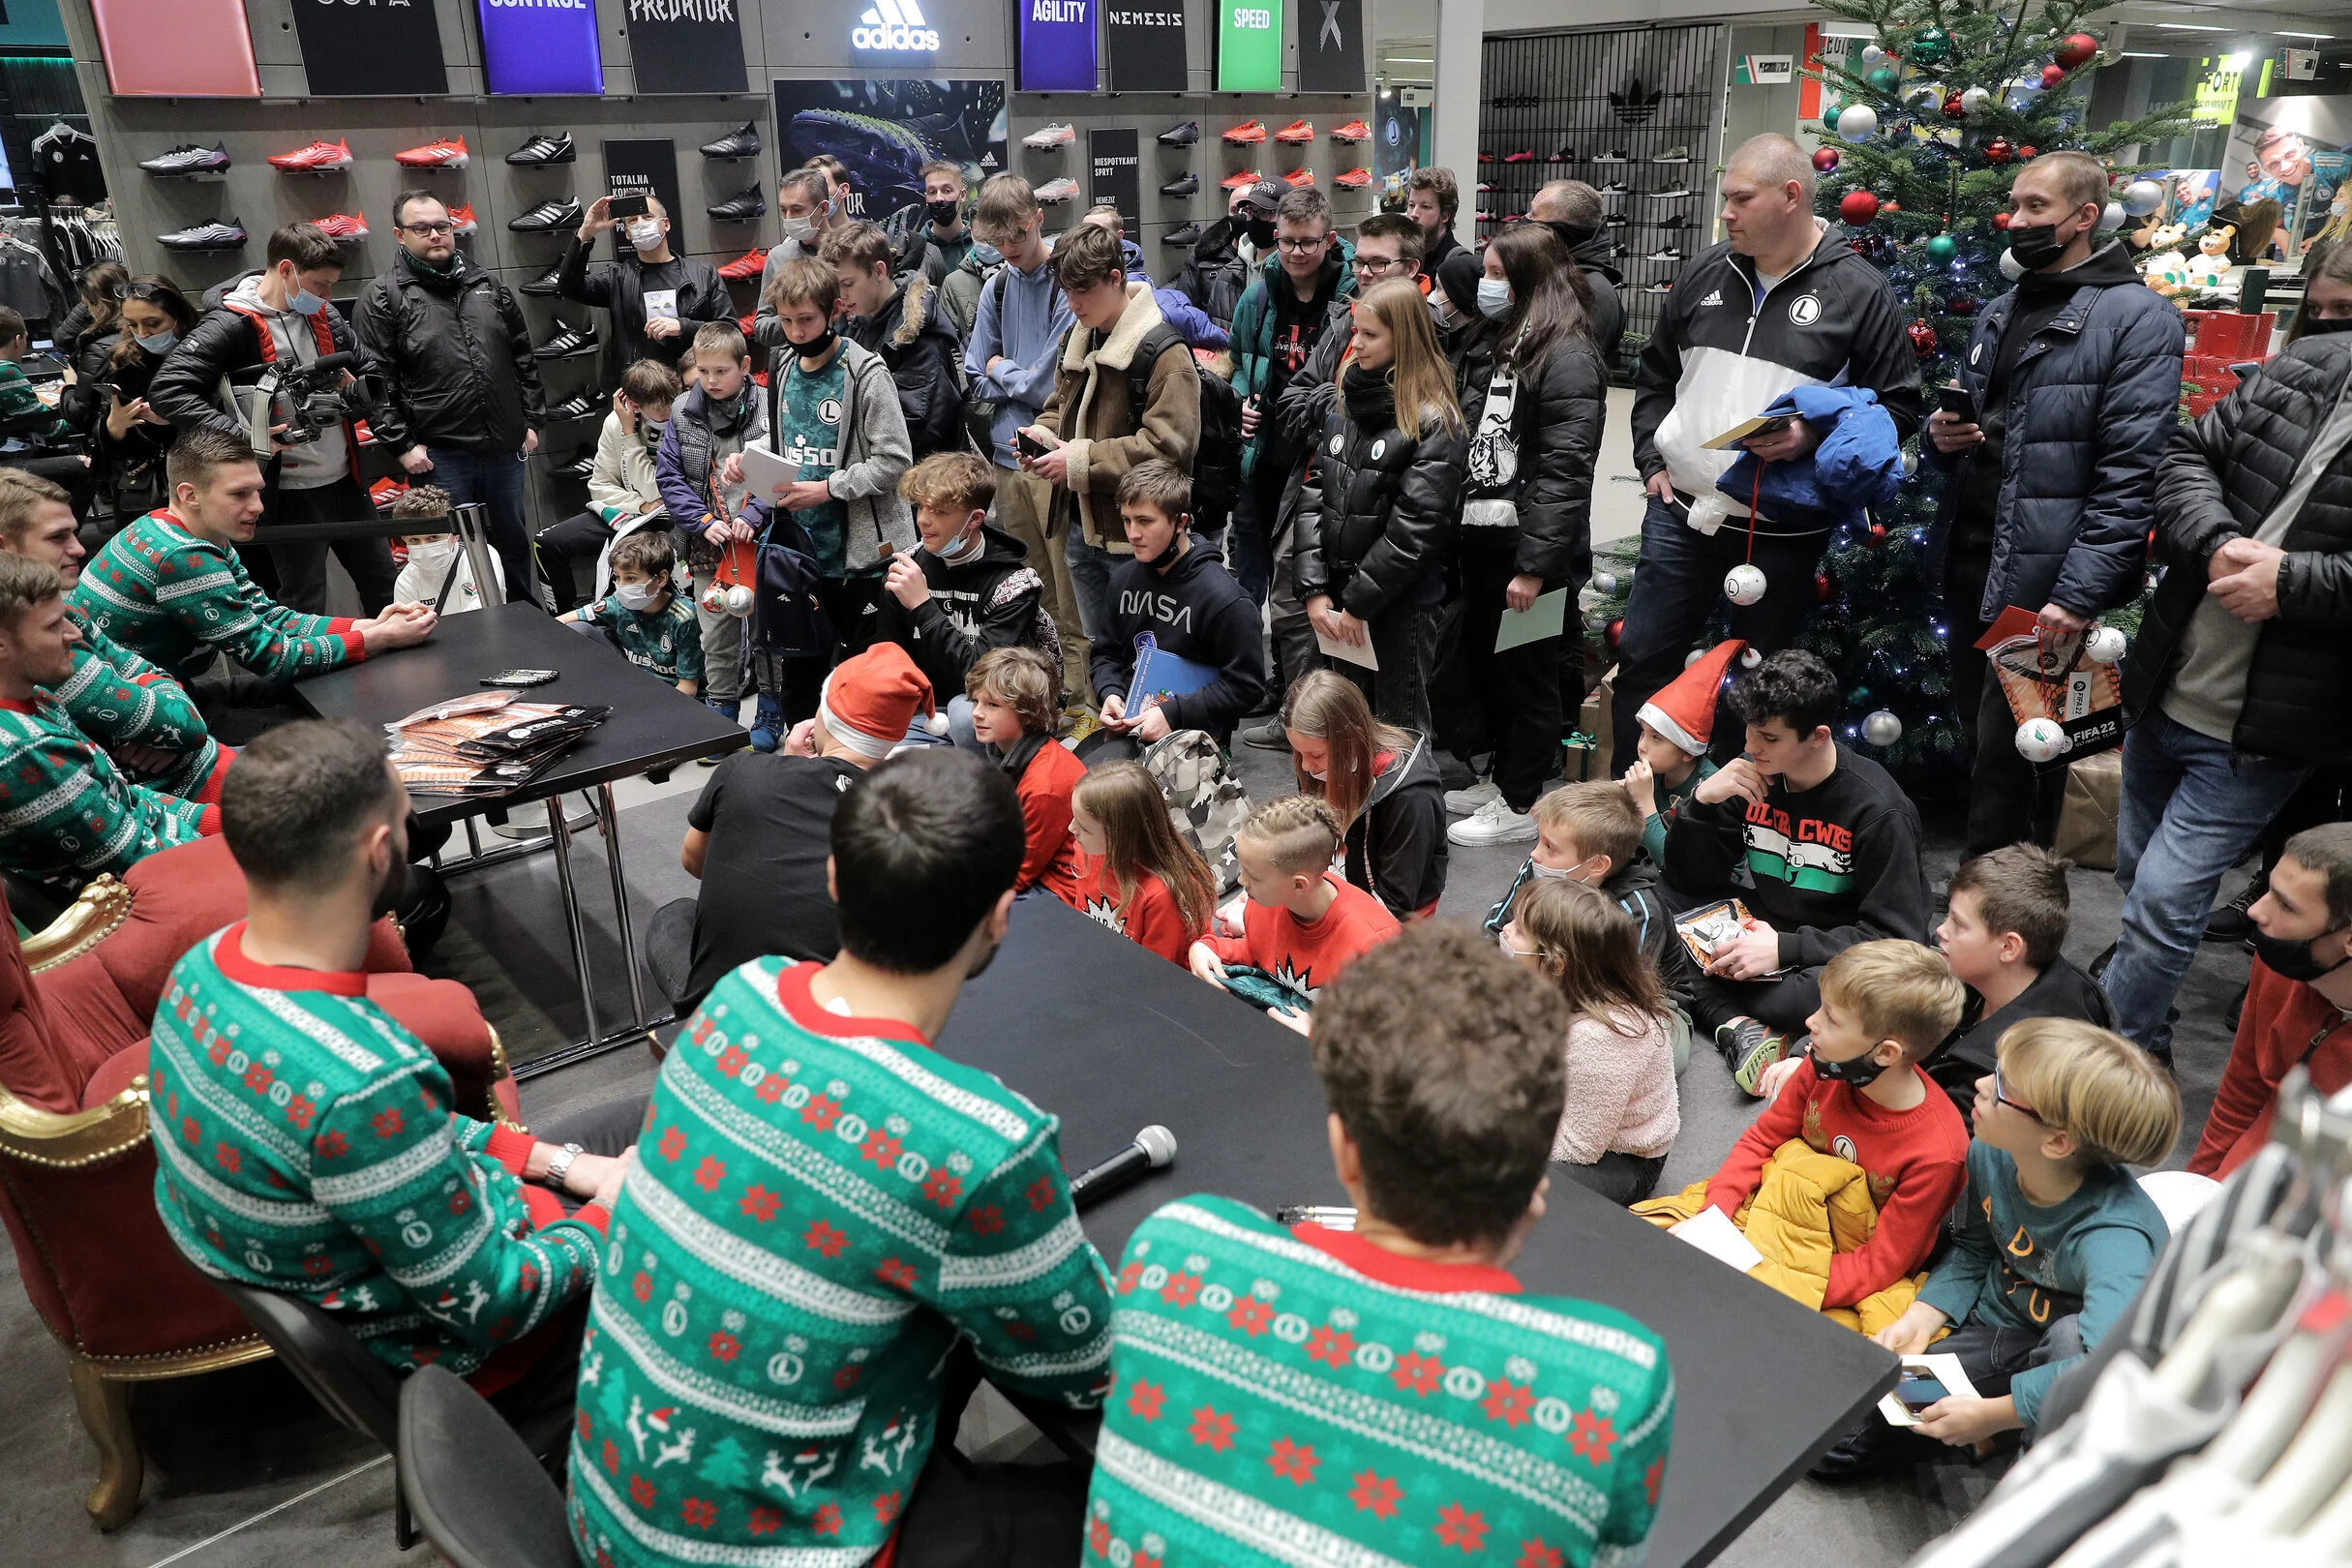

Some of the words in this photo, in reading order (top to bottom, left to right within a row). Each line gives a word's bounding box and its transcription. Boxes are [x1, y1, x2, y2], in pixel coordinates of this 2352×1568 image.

[1032, 0, 1086, 23] AGILITY
[1233, 8, 1271, 29] SPEED
[852, 22, 940, 50] adidas
[1094, 157, 1138, 166] NIESPOTYKANY
[1095, 167, 1114, 176] SPRYT
[611, 174, 649, 185] TOTALNA
[1119, 589, 1191, 634] NASA
[2075, 707, 2082, 715] 22
[2073, 727, 2100, 742] FIFA
[2100, 721, 2116, 734] 22
[2074, 736, 2101, 747] ULTIMATE
[2102, 730, 2118, 739] TEAM
[1798, 819, 1853, 853] CWKS
